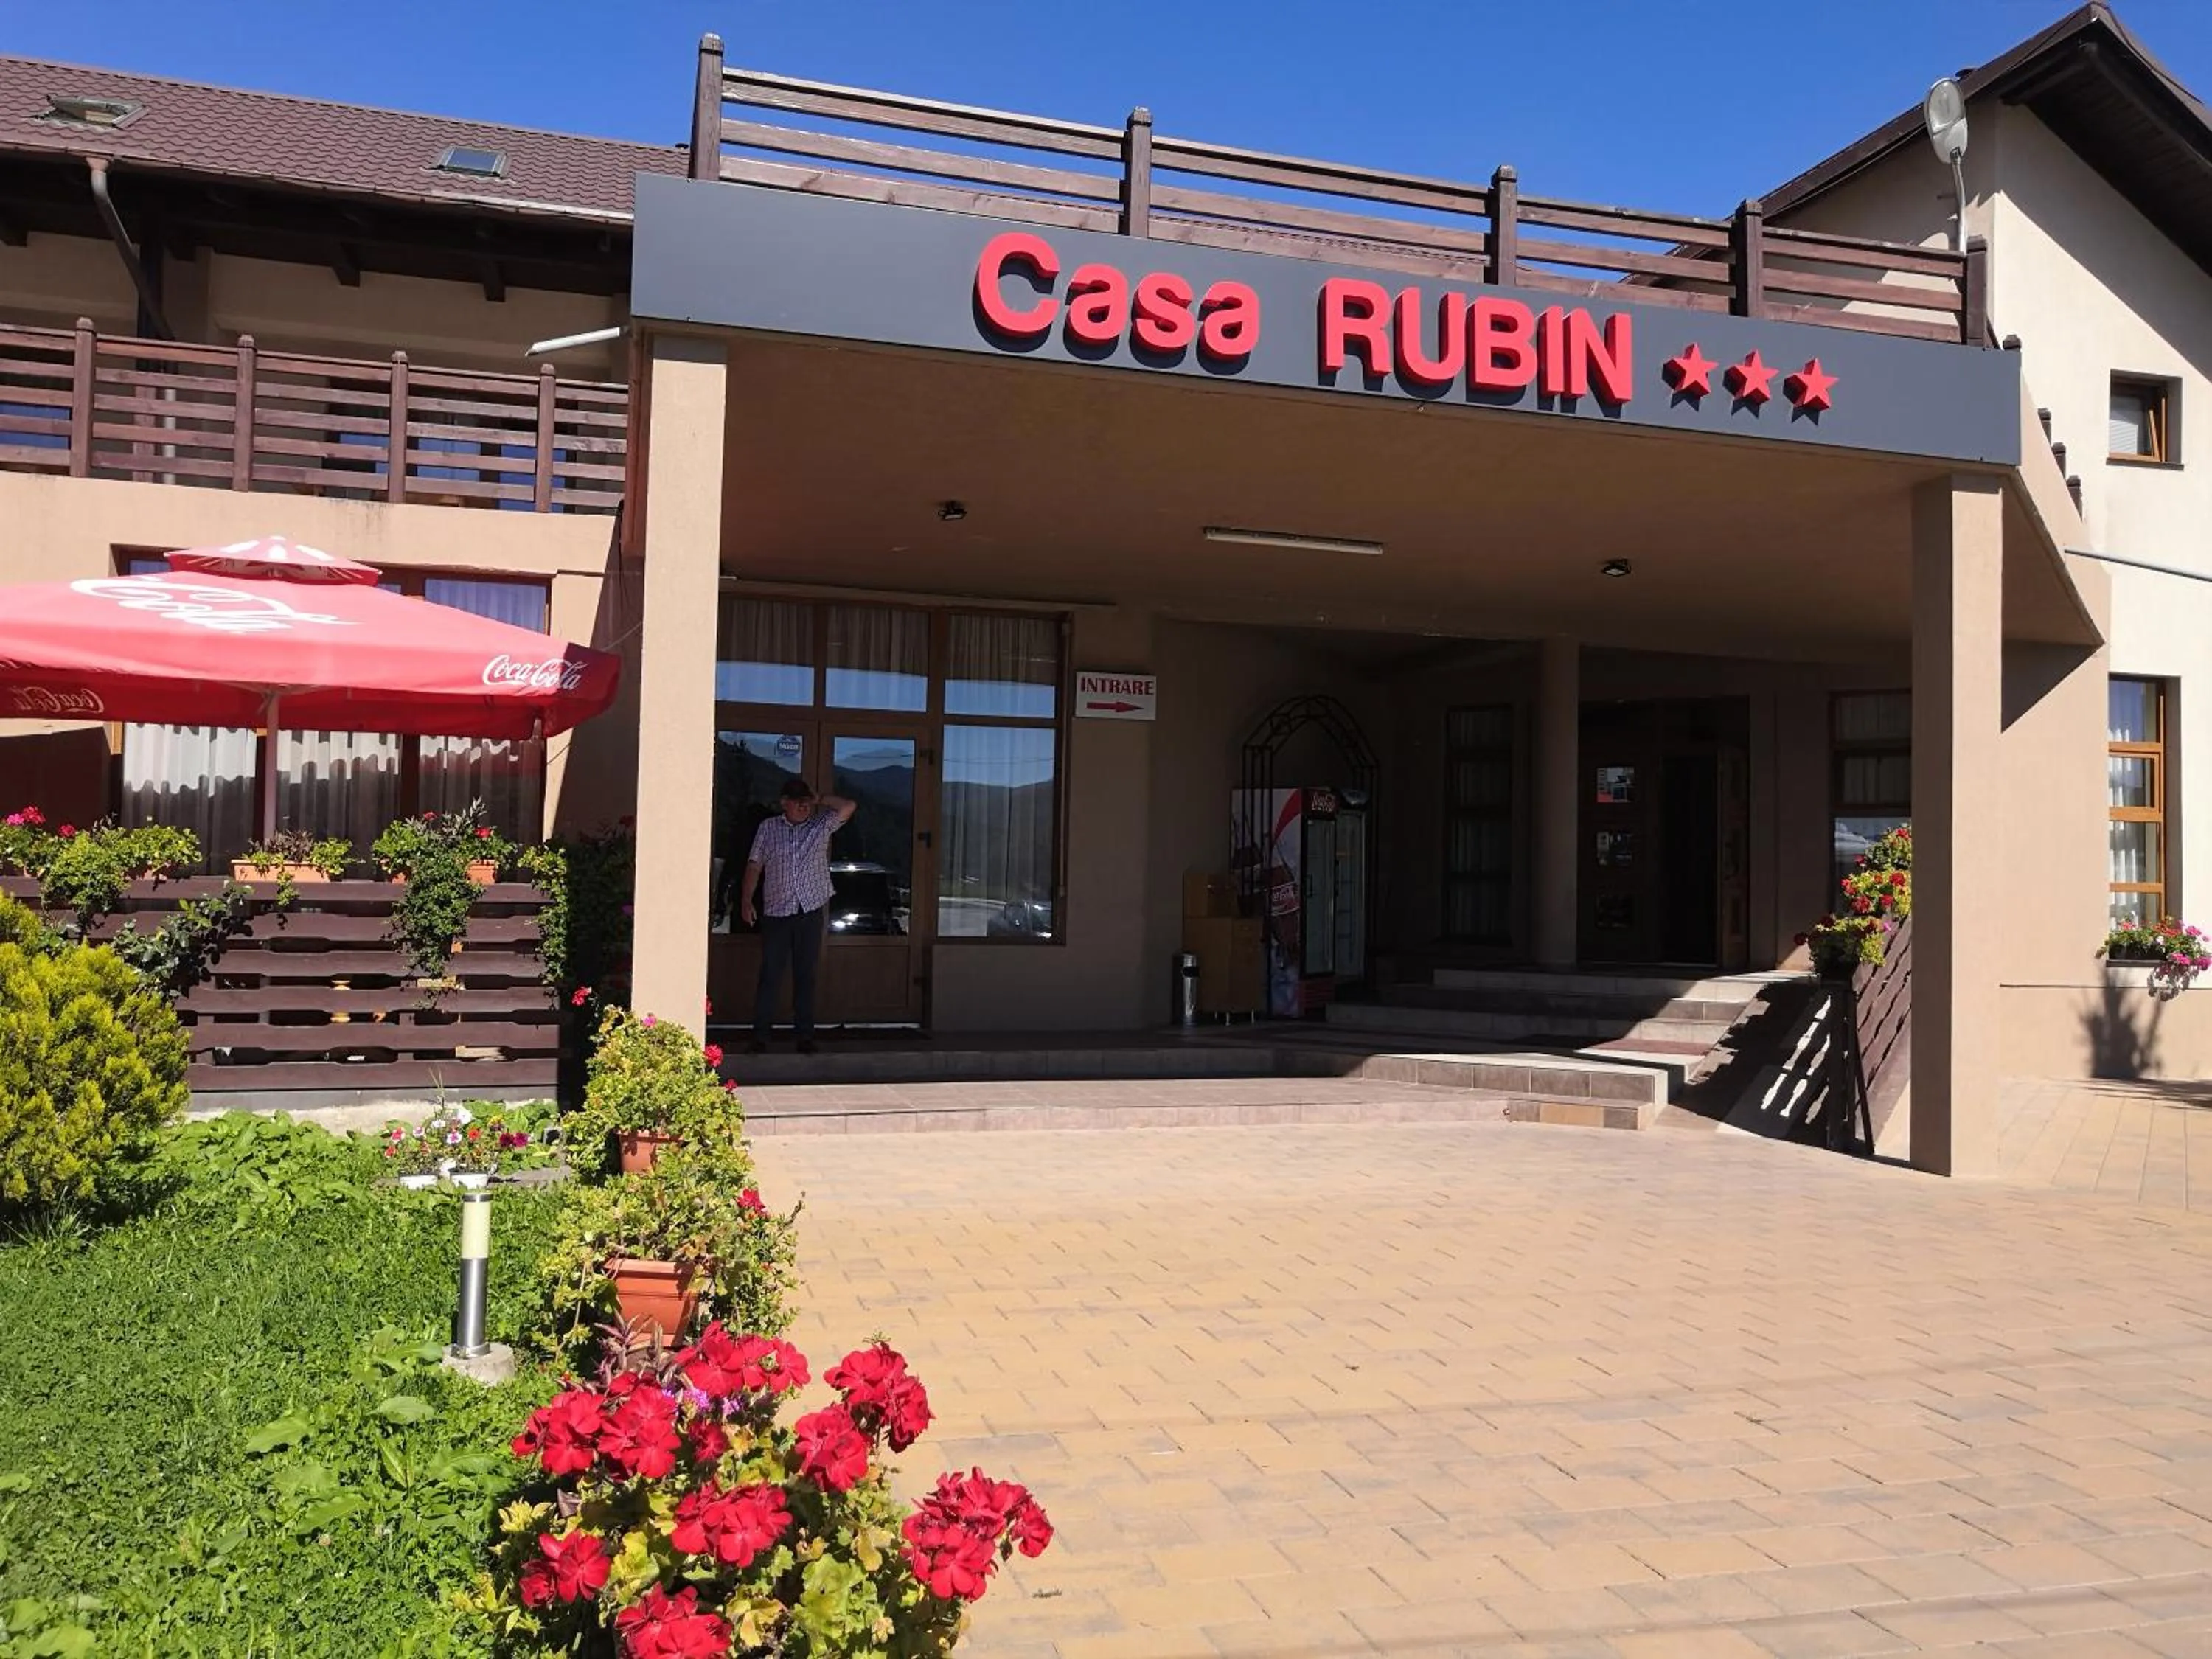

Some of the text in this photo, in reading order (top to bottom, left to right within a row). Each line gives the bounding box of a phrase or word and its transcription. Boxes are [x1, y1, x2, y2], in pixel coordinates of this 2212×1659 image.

[977, 232, 1632, 403] Casa RUBIN
[482, 653, 588, 690] Coca-Cola
[1080, 675, 1155, 695] INTRARE
